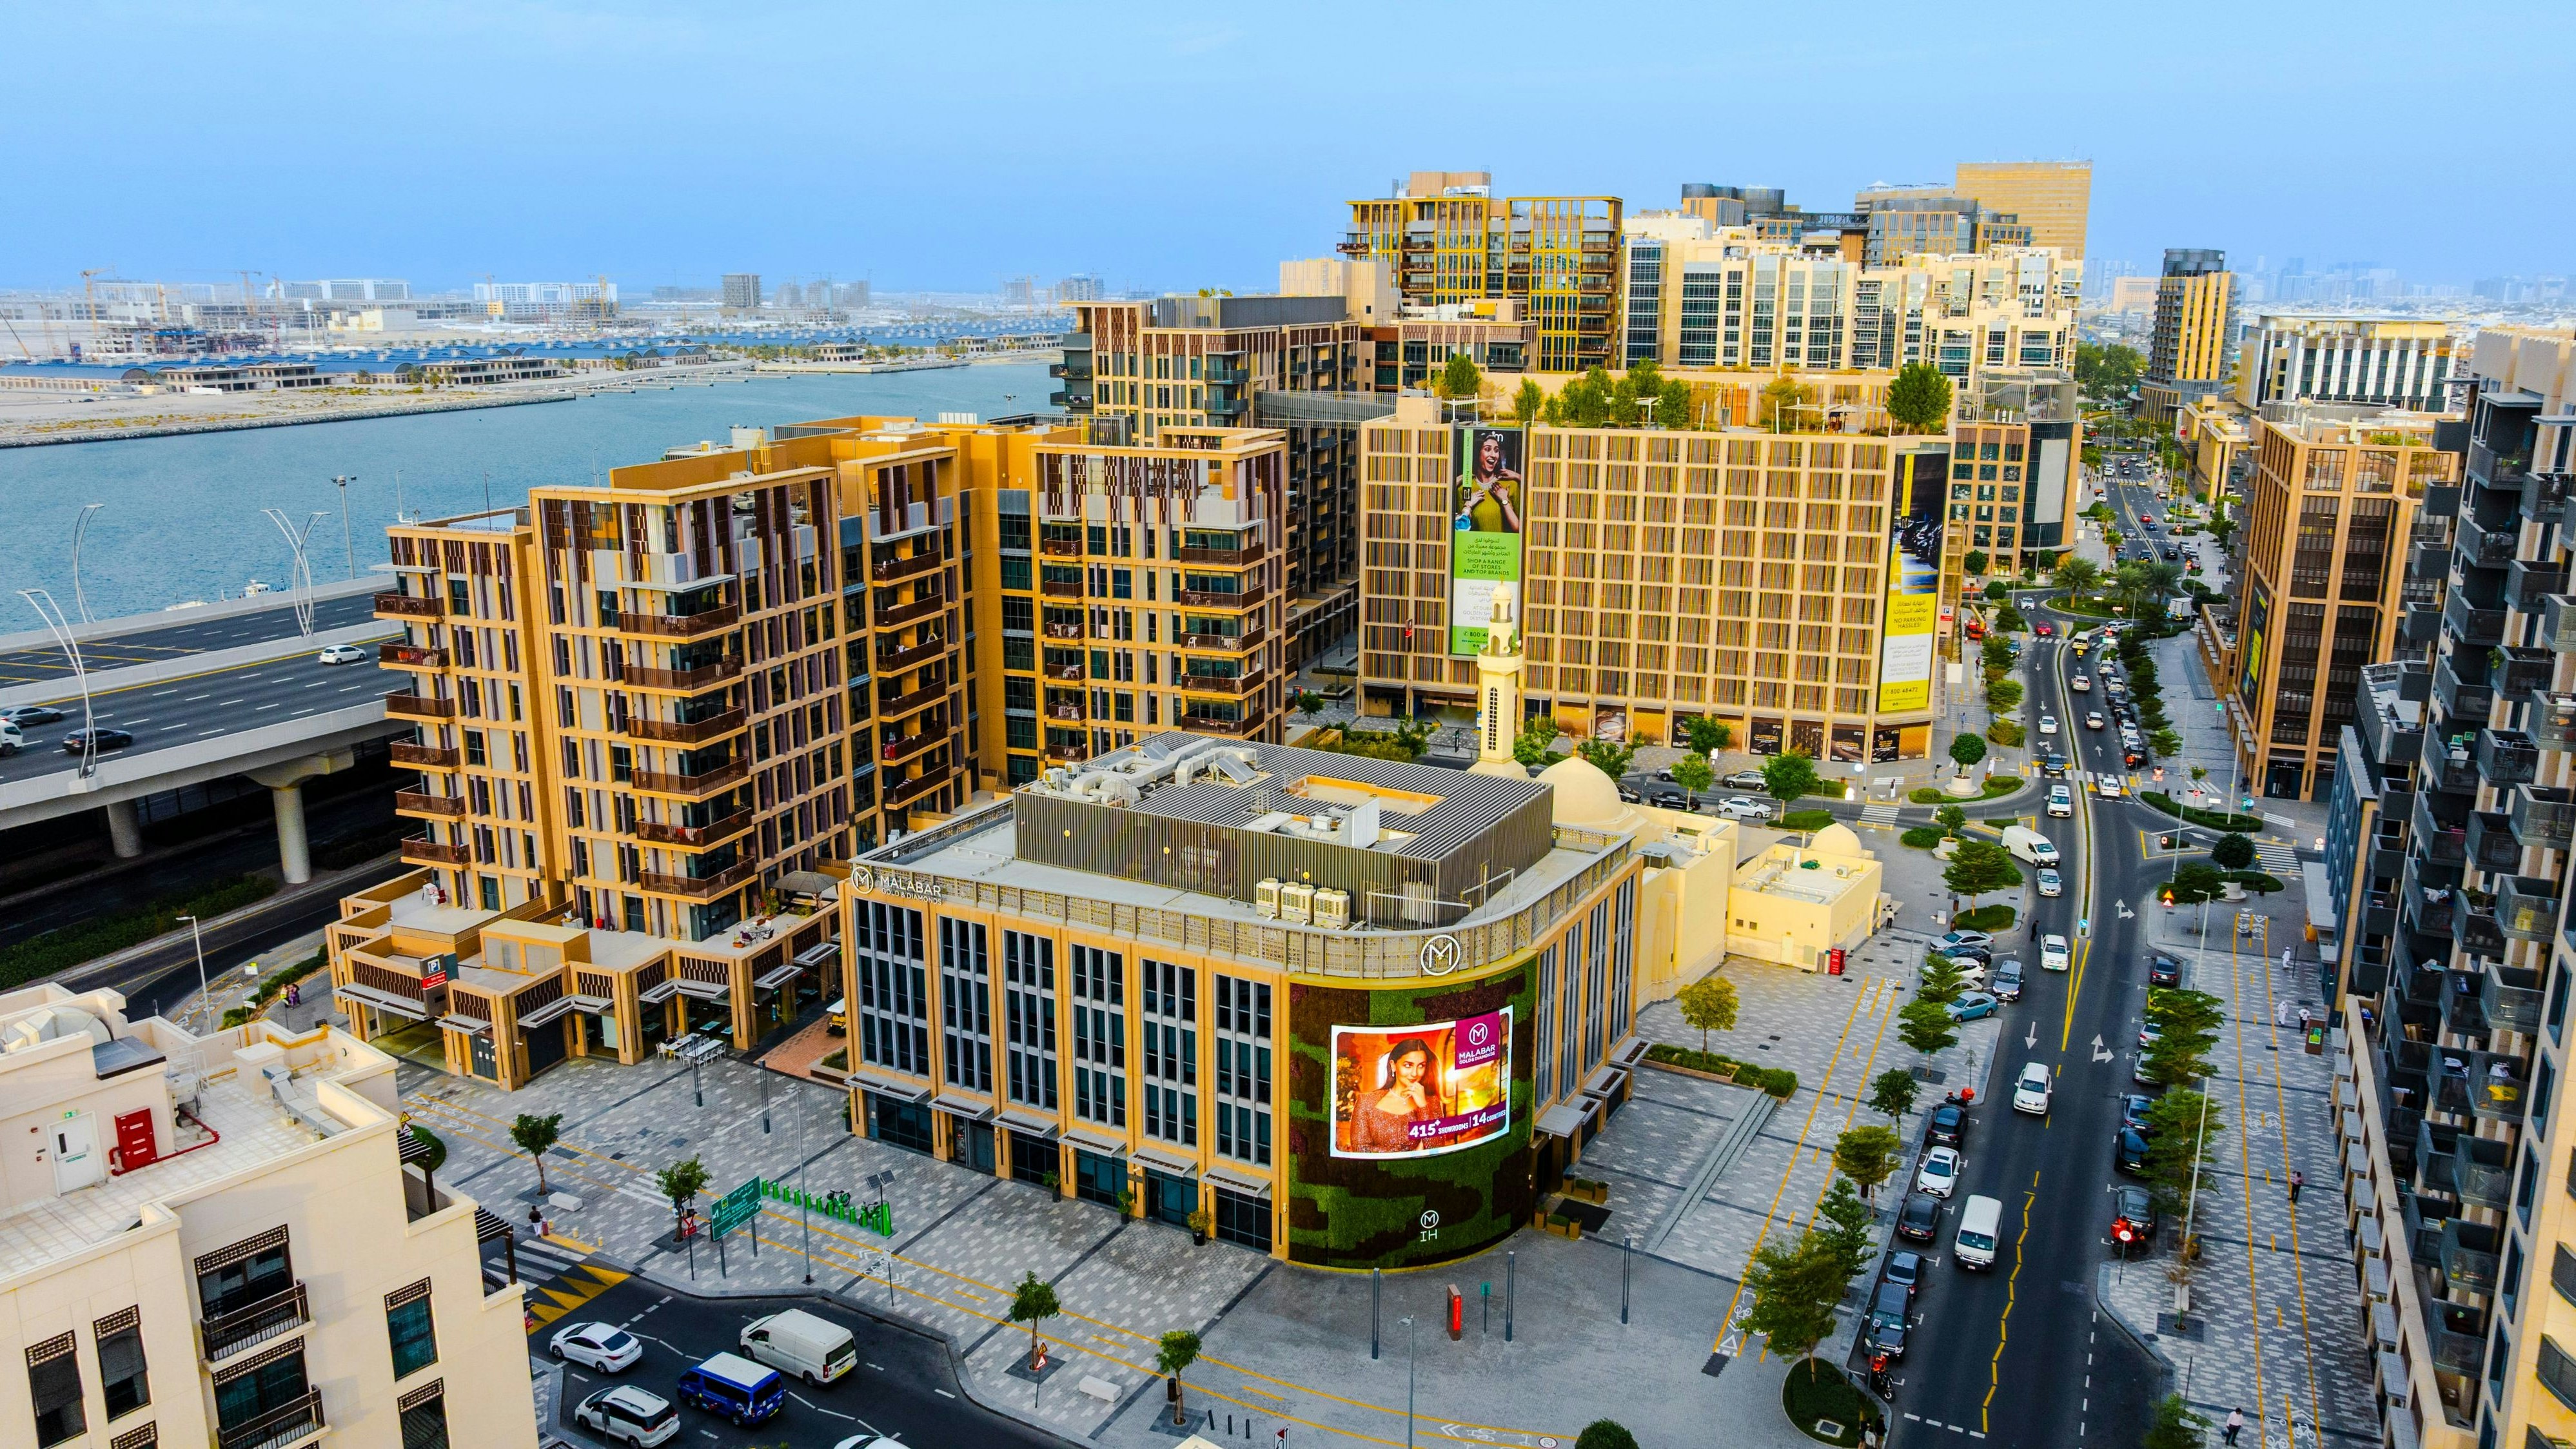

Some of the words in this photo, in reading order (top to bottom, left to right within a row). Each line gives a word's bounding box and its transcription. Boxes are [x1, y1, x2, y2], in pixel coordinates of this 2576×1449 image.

[880, 875, 941, 897] MALABAR
[881, 887, 900, 897] GOLD
[906, 893, 942, 905] DIAMONDS
[1459, 1044, 1496, 1060] MALABAR
[1475, 1051, 1495, 1061] DIAMONDS
[1438, 1122, 1469, 1134] SHOWROOMS
[1472, 1112, 1486, 1127] 14
[1486, 1110, 1506, 1122] COUNTRIES
[1420, 1228, 1437, 1242] IH
